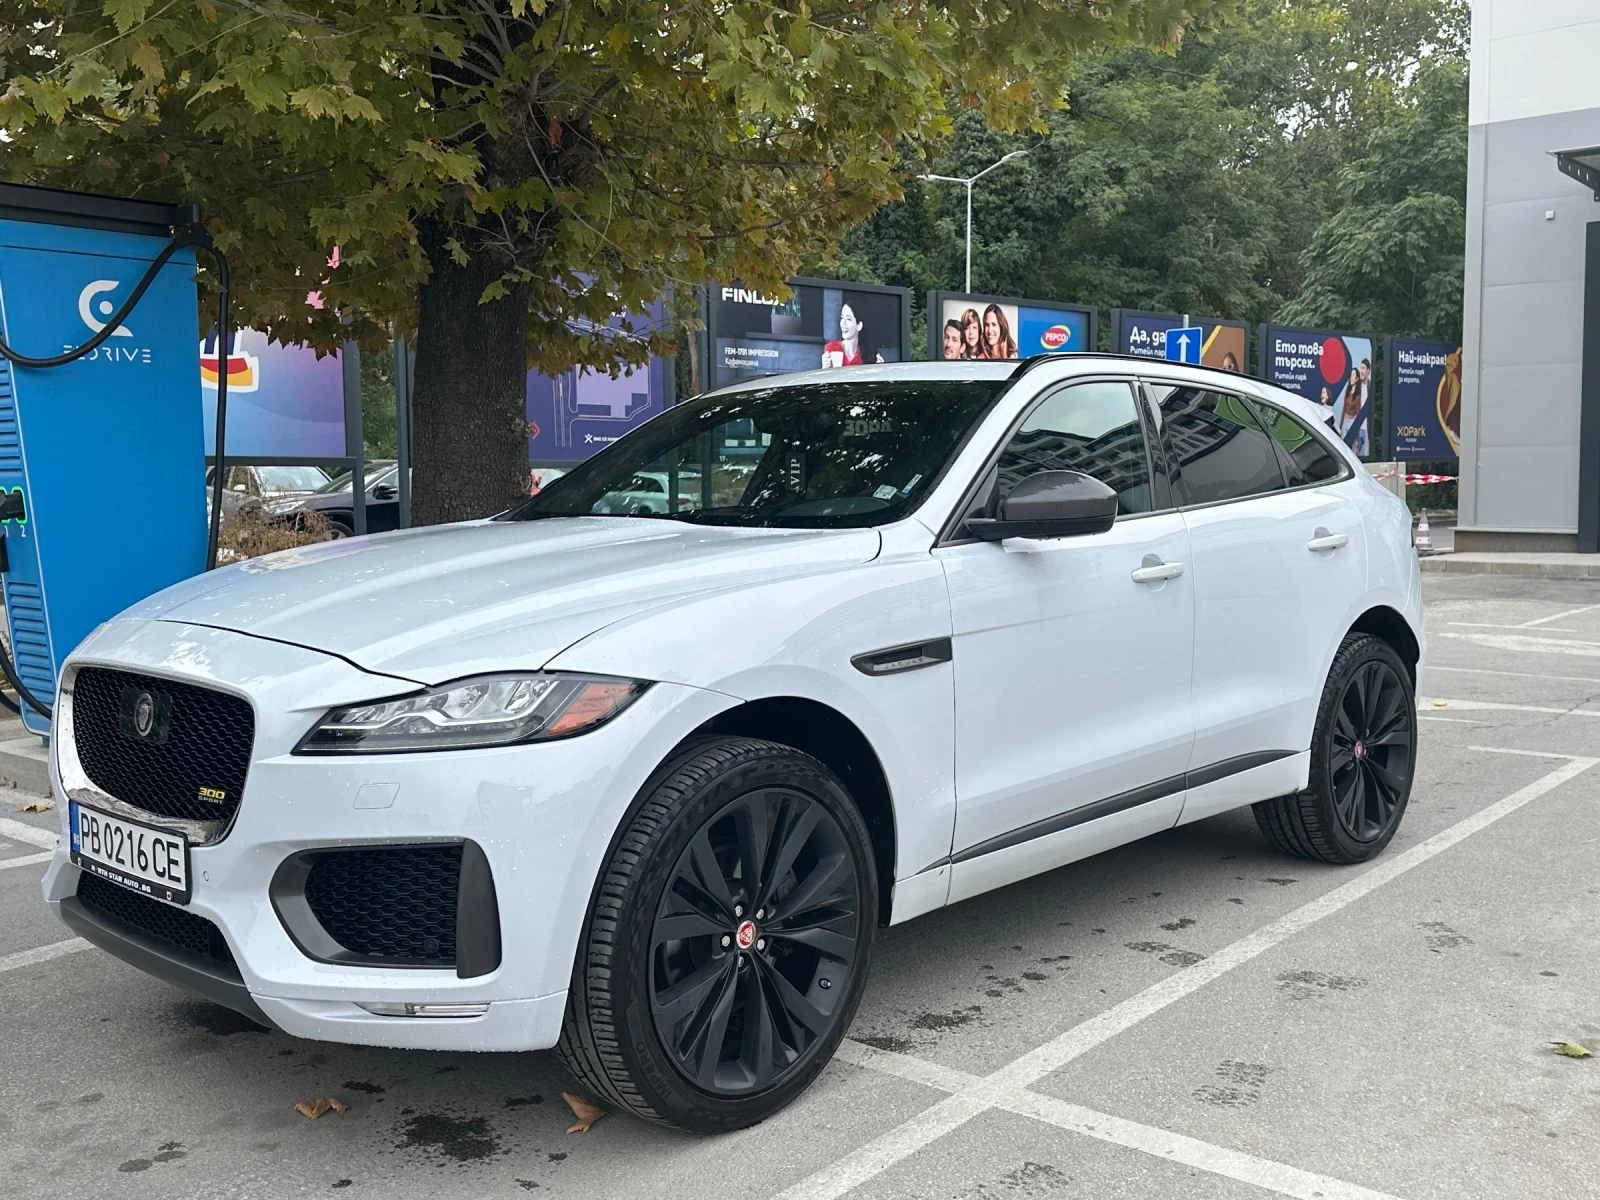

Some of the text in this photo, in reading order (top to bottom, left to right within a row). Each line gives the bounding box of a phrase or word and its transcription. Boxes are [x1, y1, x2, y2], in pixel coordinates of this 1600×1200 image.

[1045, 332, 1066, 342] PEPCO
[1130, 326, 1150, 344] Да,
[748, 348, 779, 358] IMPRESSION
[1154, 349, 1166, 358] пар
[1275, 339, 1324, 356] Ето това
[1275, 356, 1315, 371] търсех.
[790, 458, 801, 485] VIP
[20, 525, 26, 538] 2
[884, 657, 924, 669] JAGUAR
[198, 787, 225, 799] 300
[197, 795, 223, 805] SPORT
[80, 812, 181, 884] PB 0216 CE
[108, 872, 122, 883] STAR
